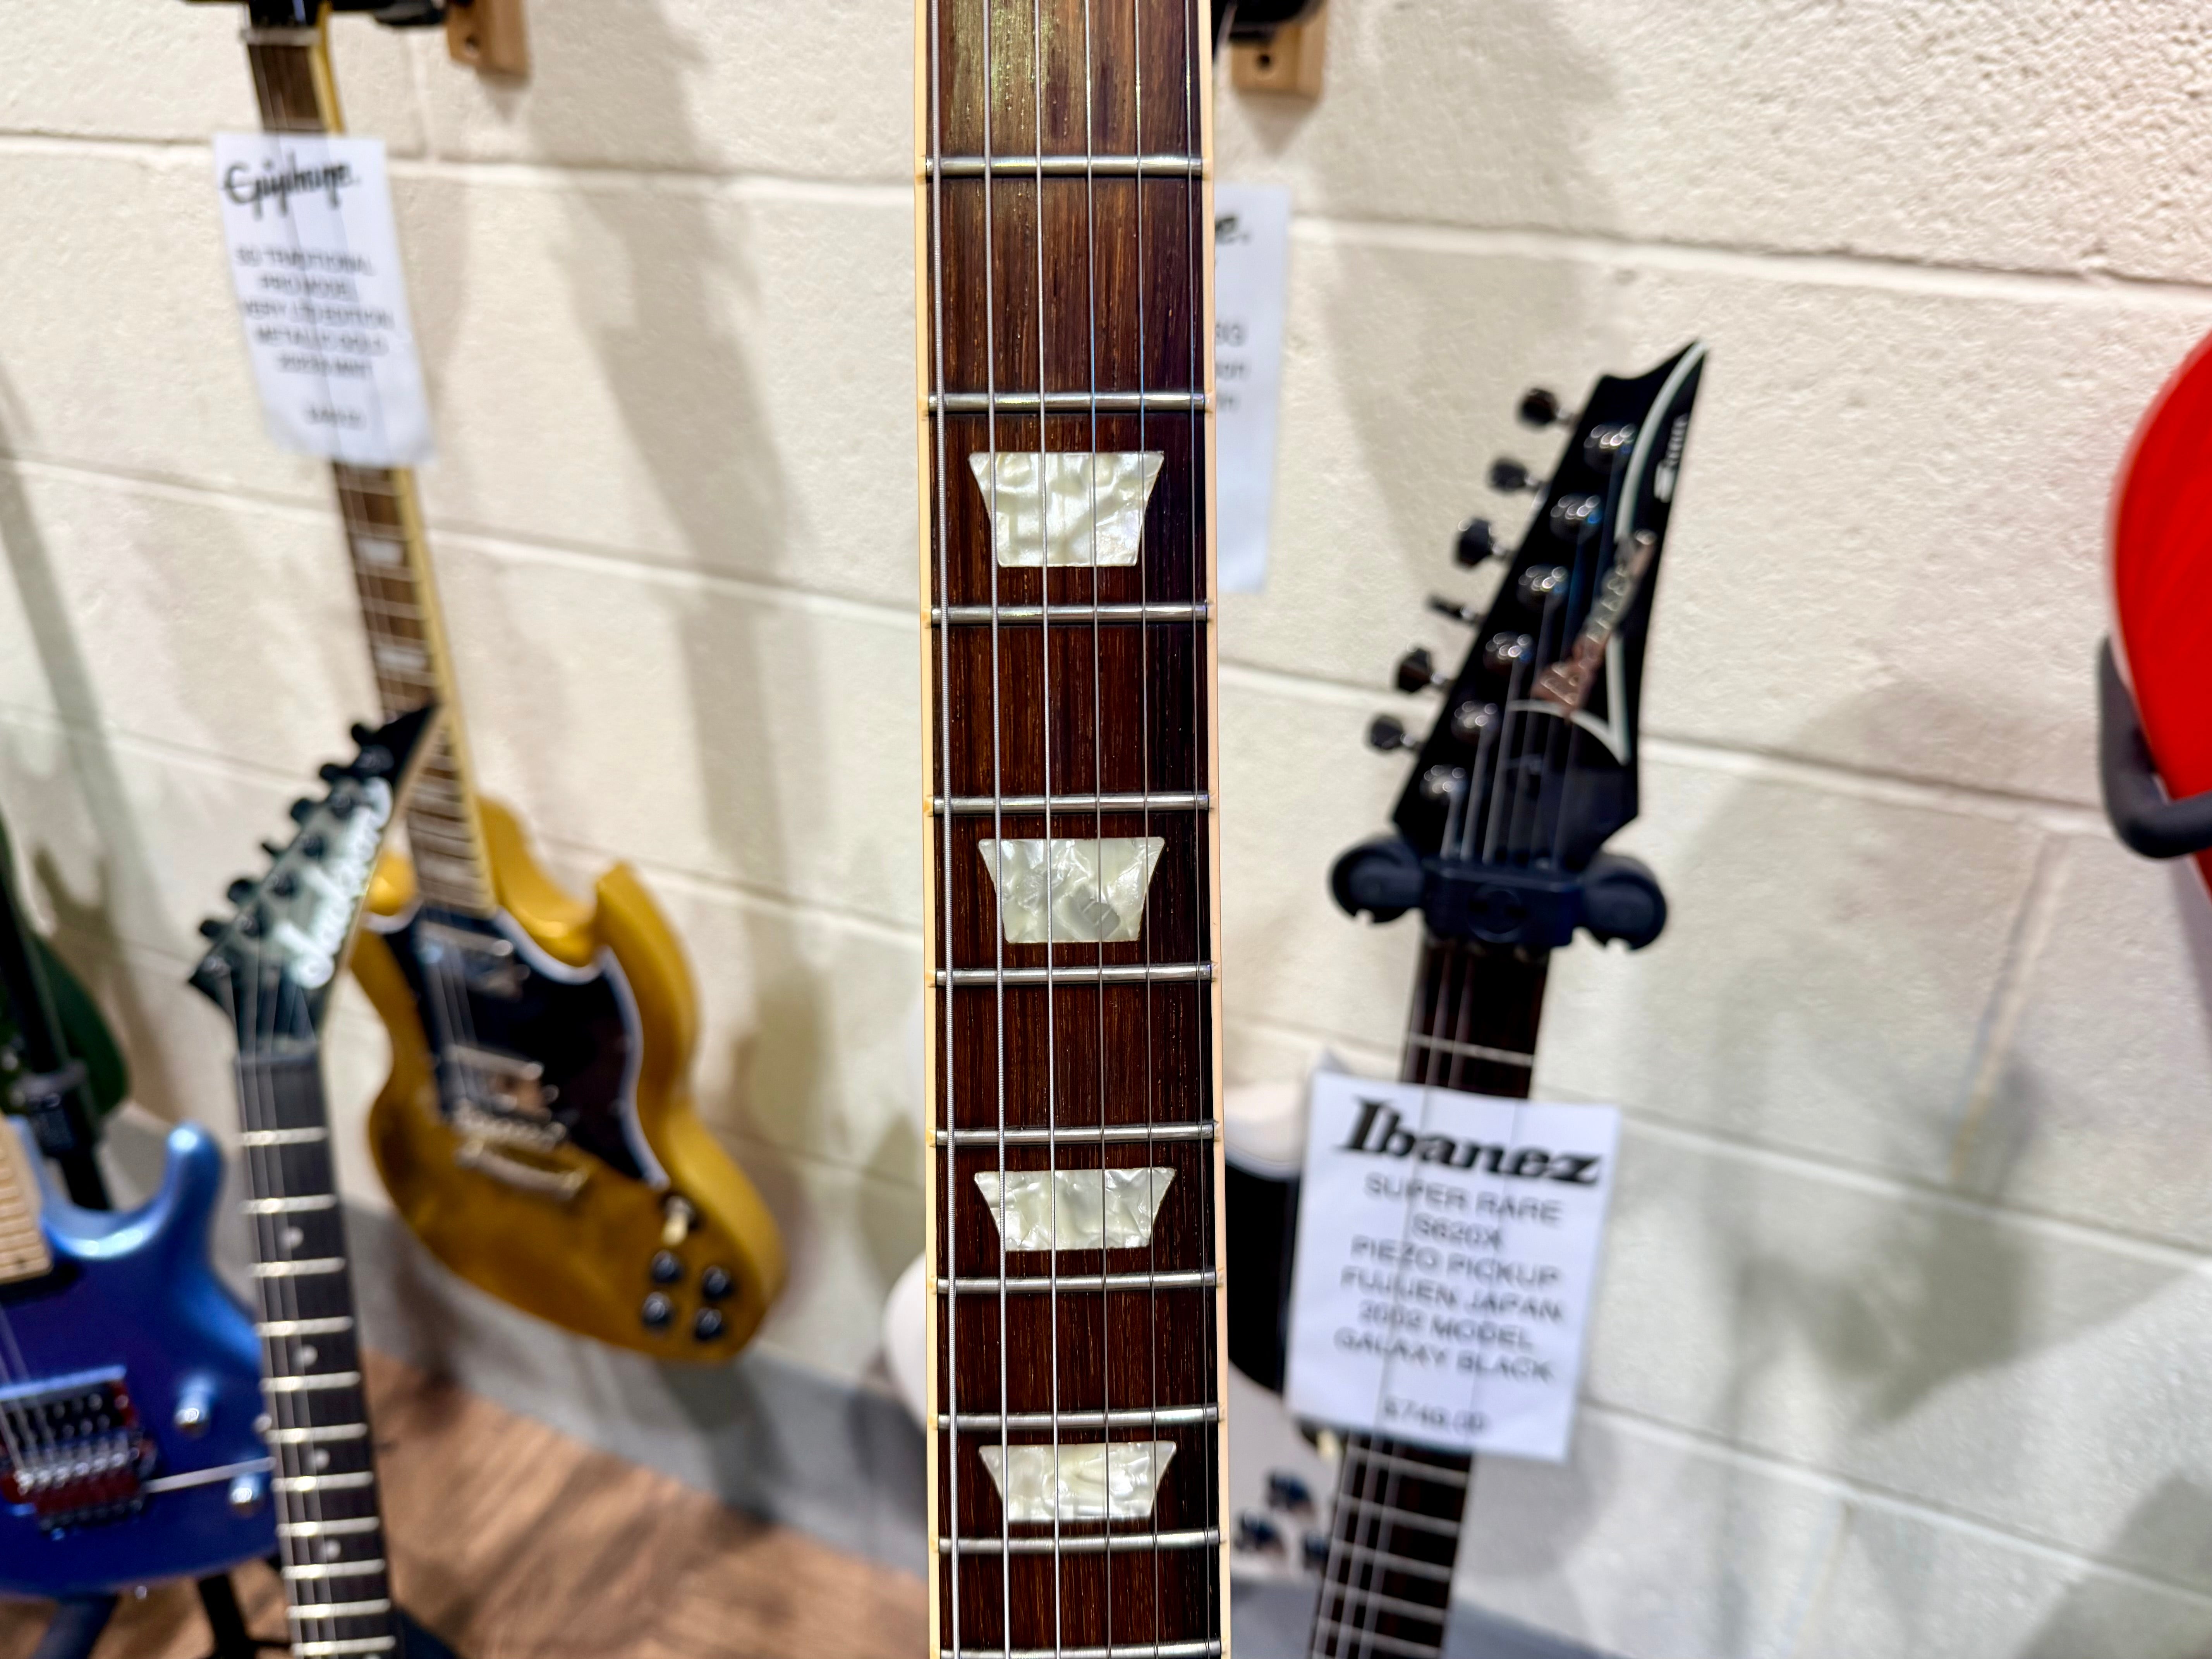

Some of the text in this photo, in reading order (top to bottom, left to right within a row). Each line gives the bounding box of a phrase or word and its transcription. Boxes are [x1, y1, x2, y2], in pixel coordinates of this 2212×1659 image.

[1333, 1094, 1603, 1187] Ibanez
[1364, 1172, 1564, 1226] SUPER RARE
[1350, 1234, 1560, 1288] PIEZO PICKUP
[1465, 1287, 1565, 1323] JAPAN
[1430, 1315, 1534, 1348] MODEL
[1456, 1348, 1556, 1383] BLACK
